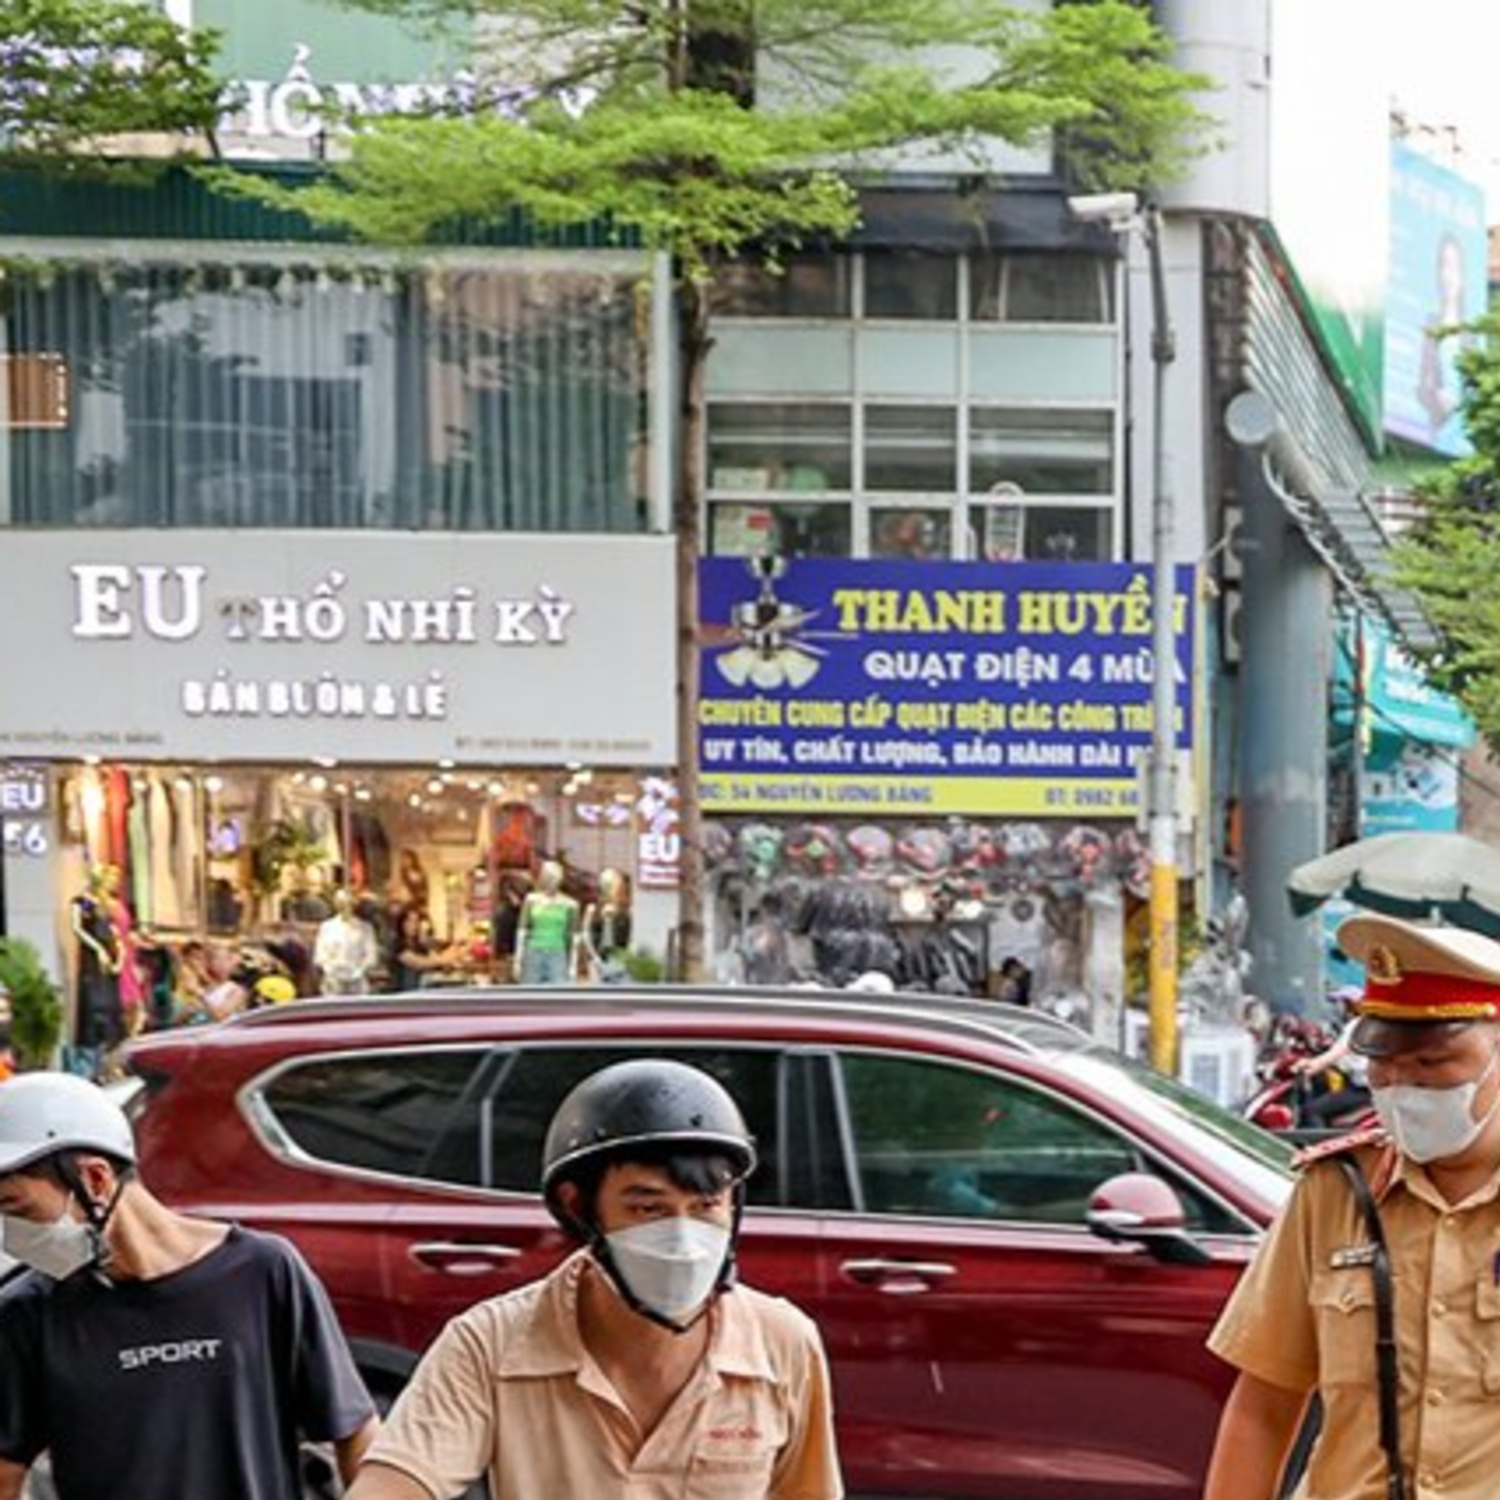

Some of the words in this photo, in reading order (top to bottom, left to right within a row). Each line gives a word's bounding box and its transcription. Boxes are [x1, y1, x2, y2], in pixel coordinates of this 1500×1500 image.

[69, 564, 208, 641] EU
[217, 568, 347, 641] THỔ
[364, 585, 478, 641] NHĨ
[494, 583, 575, 643] KỲ
[832, 588, 1006, 634] THANH
[863, 651, 966, 688] QUẠT
[974, 646, 1059, 689] ĐIỆN
[1067, 652, 1094, 683] 4
[183, 666, 260, 717] BÁN
[1009, 698, 1053, 732] CÁC
[703, 738, 737, 762] UY
[794, 734, 855, 763] CHẤT
[952, 736, 1003, 766] BẢO
[1008, 740, 1075, 767] HÀNH
[118, 1338, 223, 1371] SPORT
